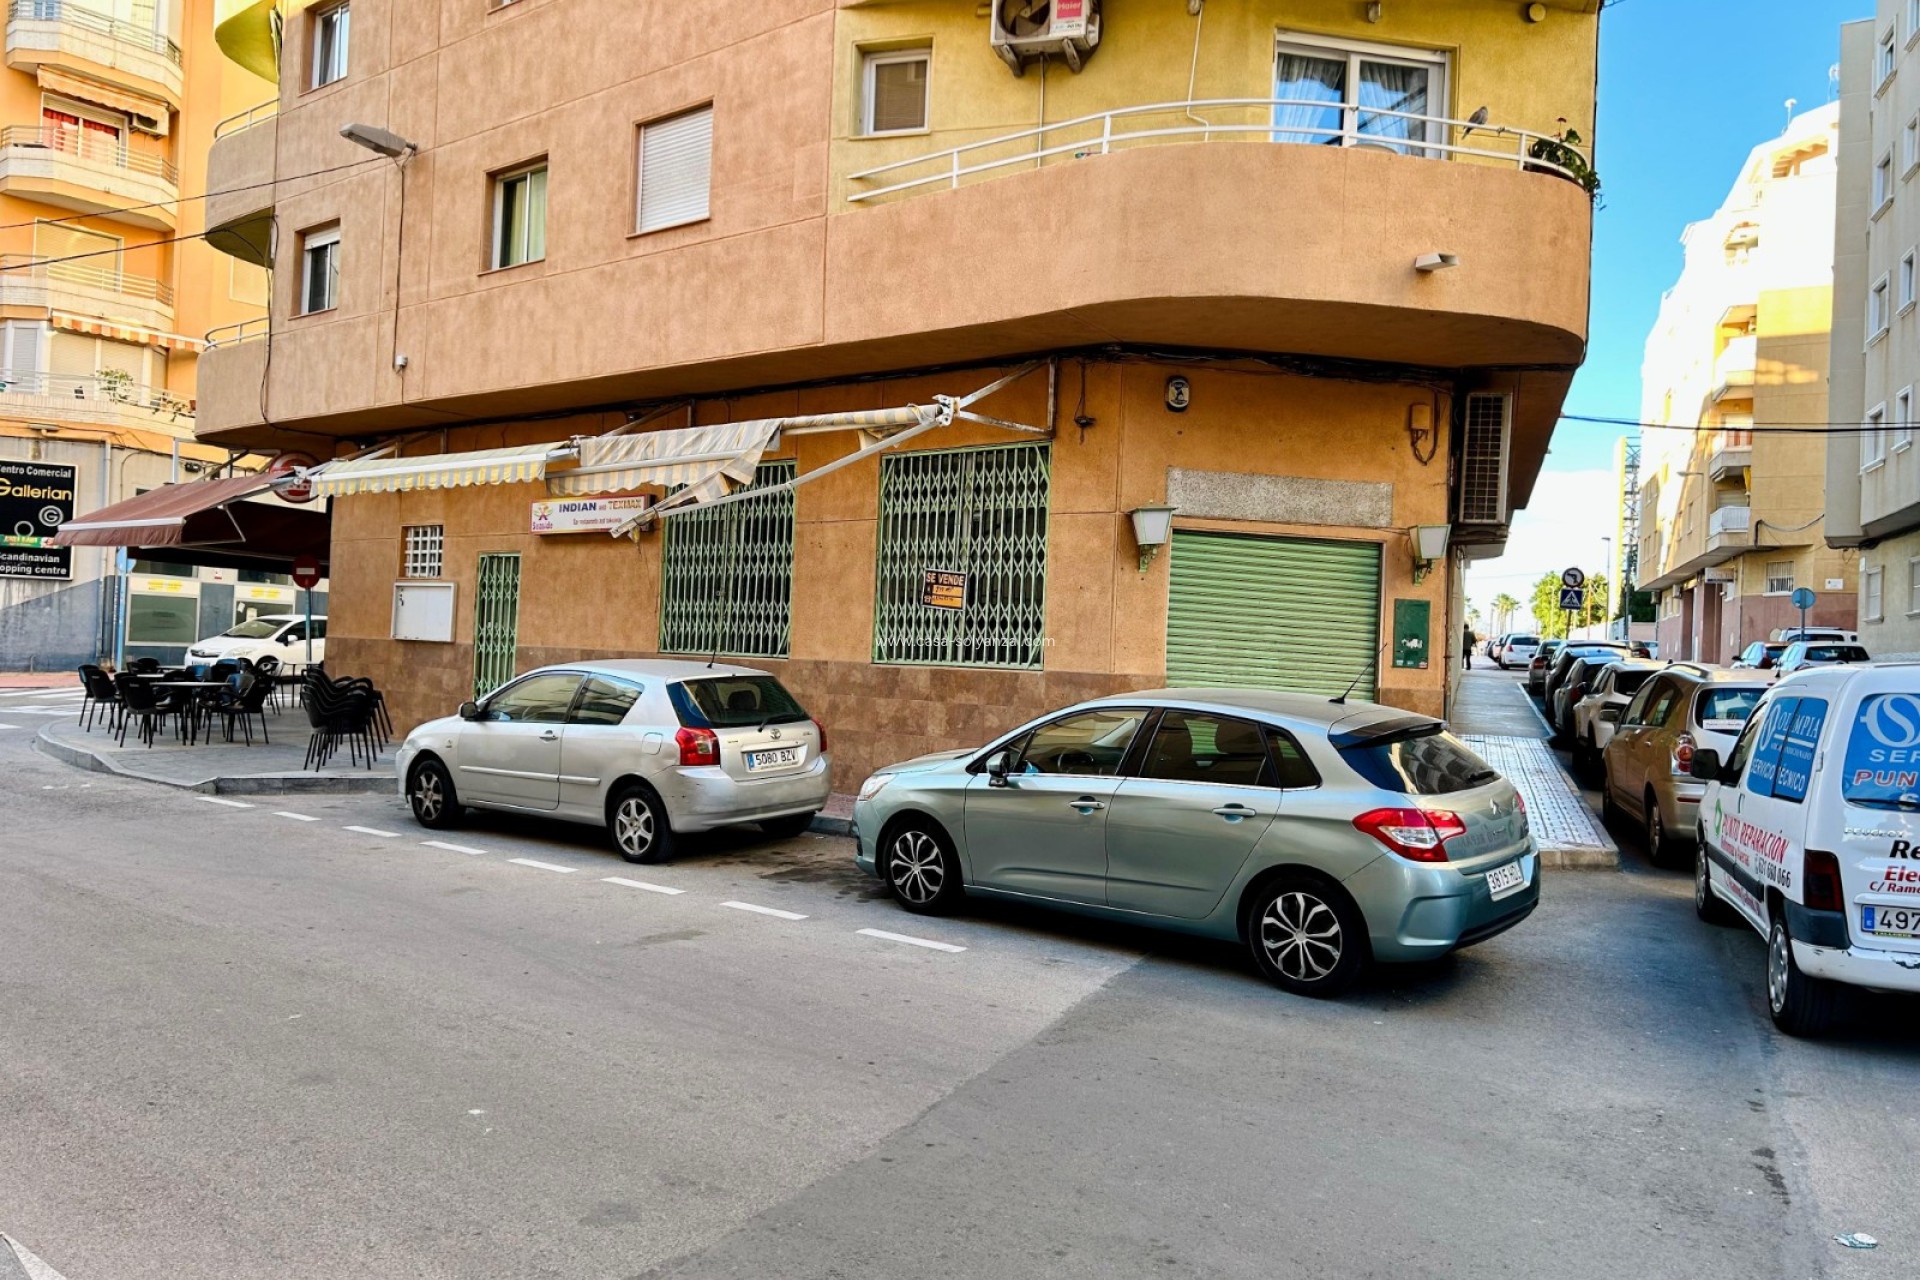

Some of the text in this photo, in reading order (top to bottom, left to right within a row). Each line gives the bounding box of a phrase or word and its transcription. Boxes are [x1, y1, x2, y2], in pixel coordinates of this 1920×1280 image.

[0, 464, 72, 478] entro Comercial
[0, 477, 72, 501] Gallerian
[558, 502, 597, 513] INDIAN
[0, 551, 60, 563] candinavian
[35, 565, 67, 575] centre
[926, 572, 965, 587] SE VENDE
[1776, 711, 1821, 739] OLMPIA
[1852, 769, 1918, 788] PUN
[1884, 864, 1920, 883] Ele
[1880, 910, 1920, 931] 497
